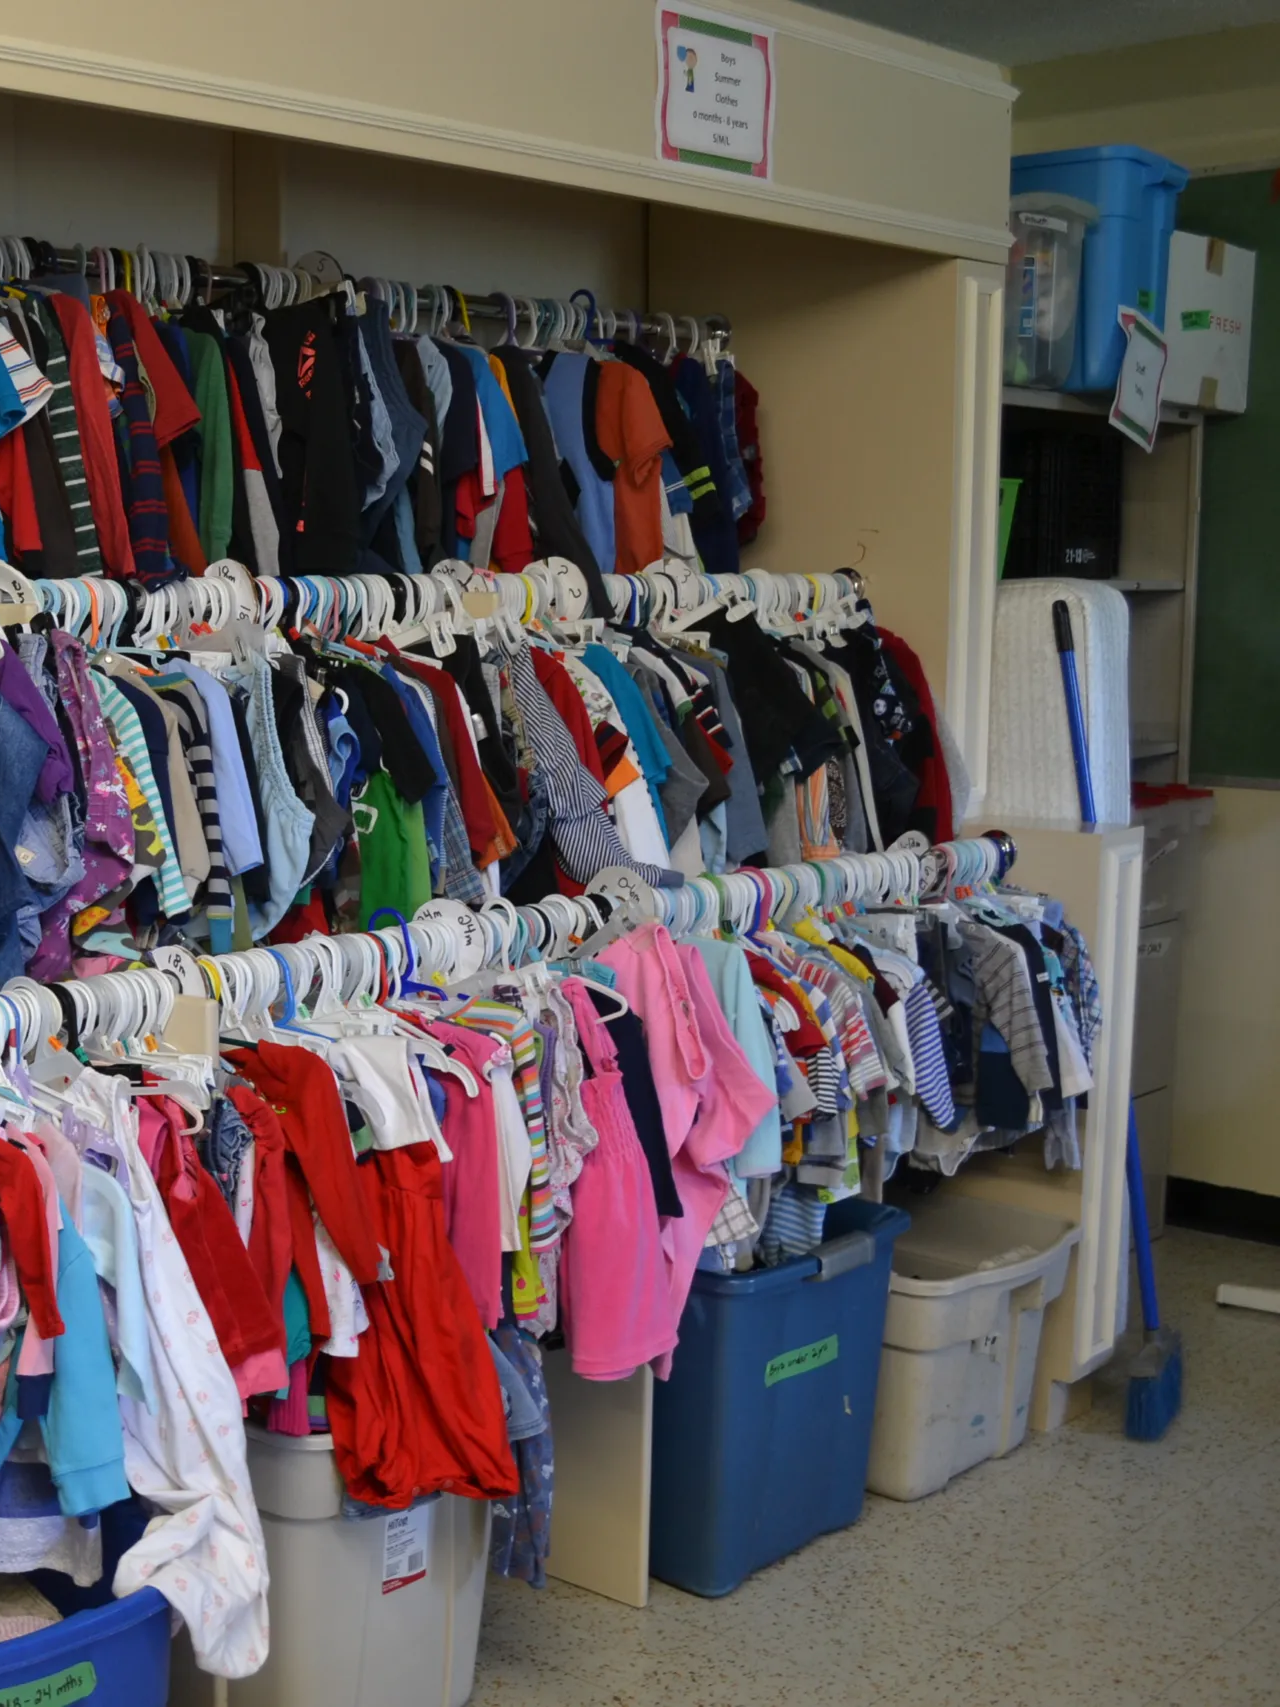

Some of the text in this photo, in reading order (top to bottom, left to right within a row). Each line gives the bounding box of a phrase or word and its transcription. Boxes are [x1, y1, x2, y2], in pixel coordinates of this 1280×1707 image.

[720, 53, 737, 67] Boys
[714, 72, 742, 87] Summer
[715, 93, 739, 107] Clothes
[698, 112, 722, 125] months
[731, 120, 749, 130] years
[316, 257, 328, 272] 5
[1209, 314, 1242, 335] FRESH
[218, 565, 236, 584] 18m
[457, 914, 477, 947] 24m
